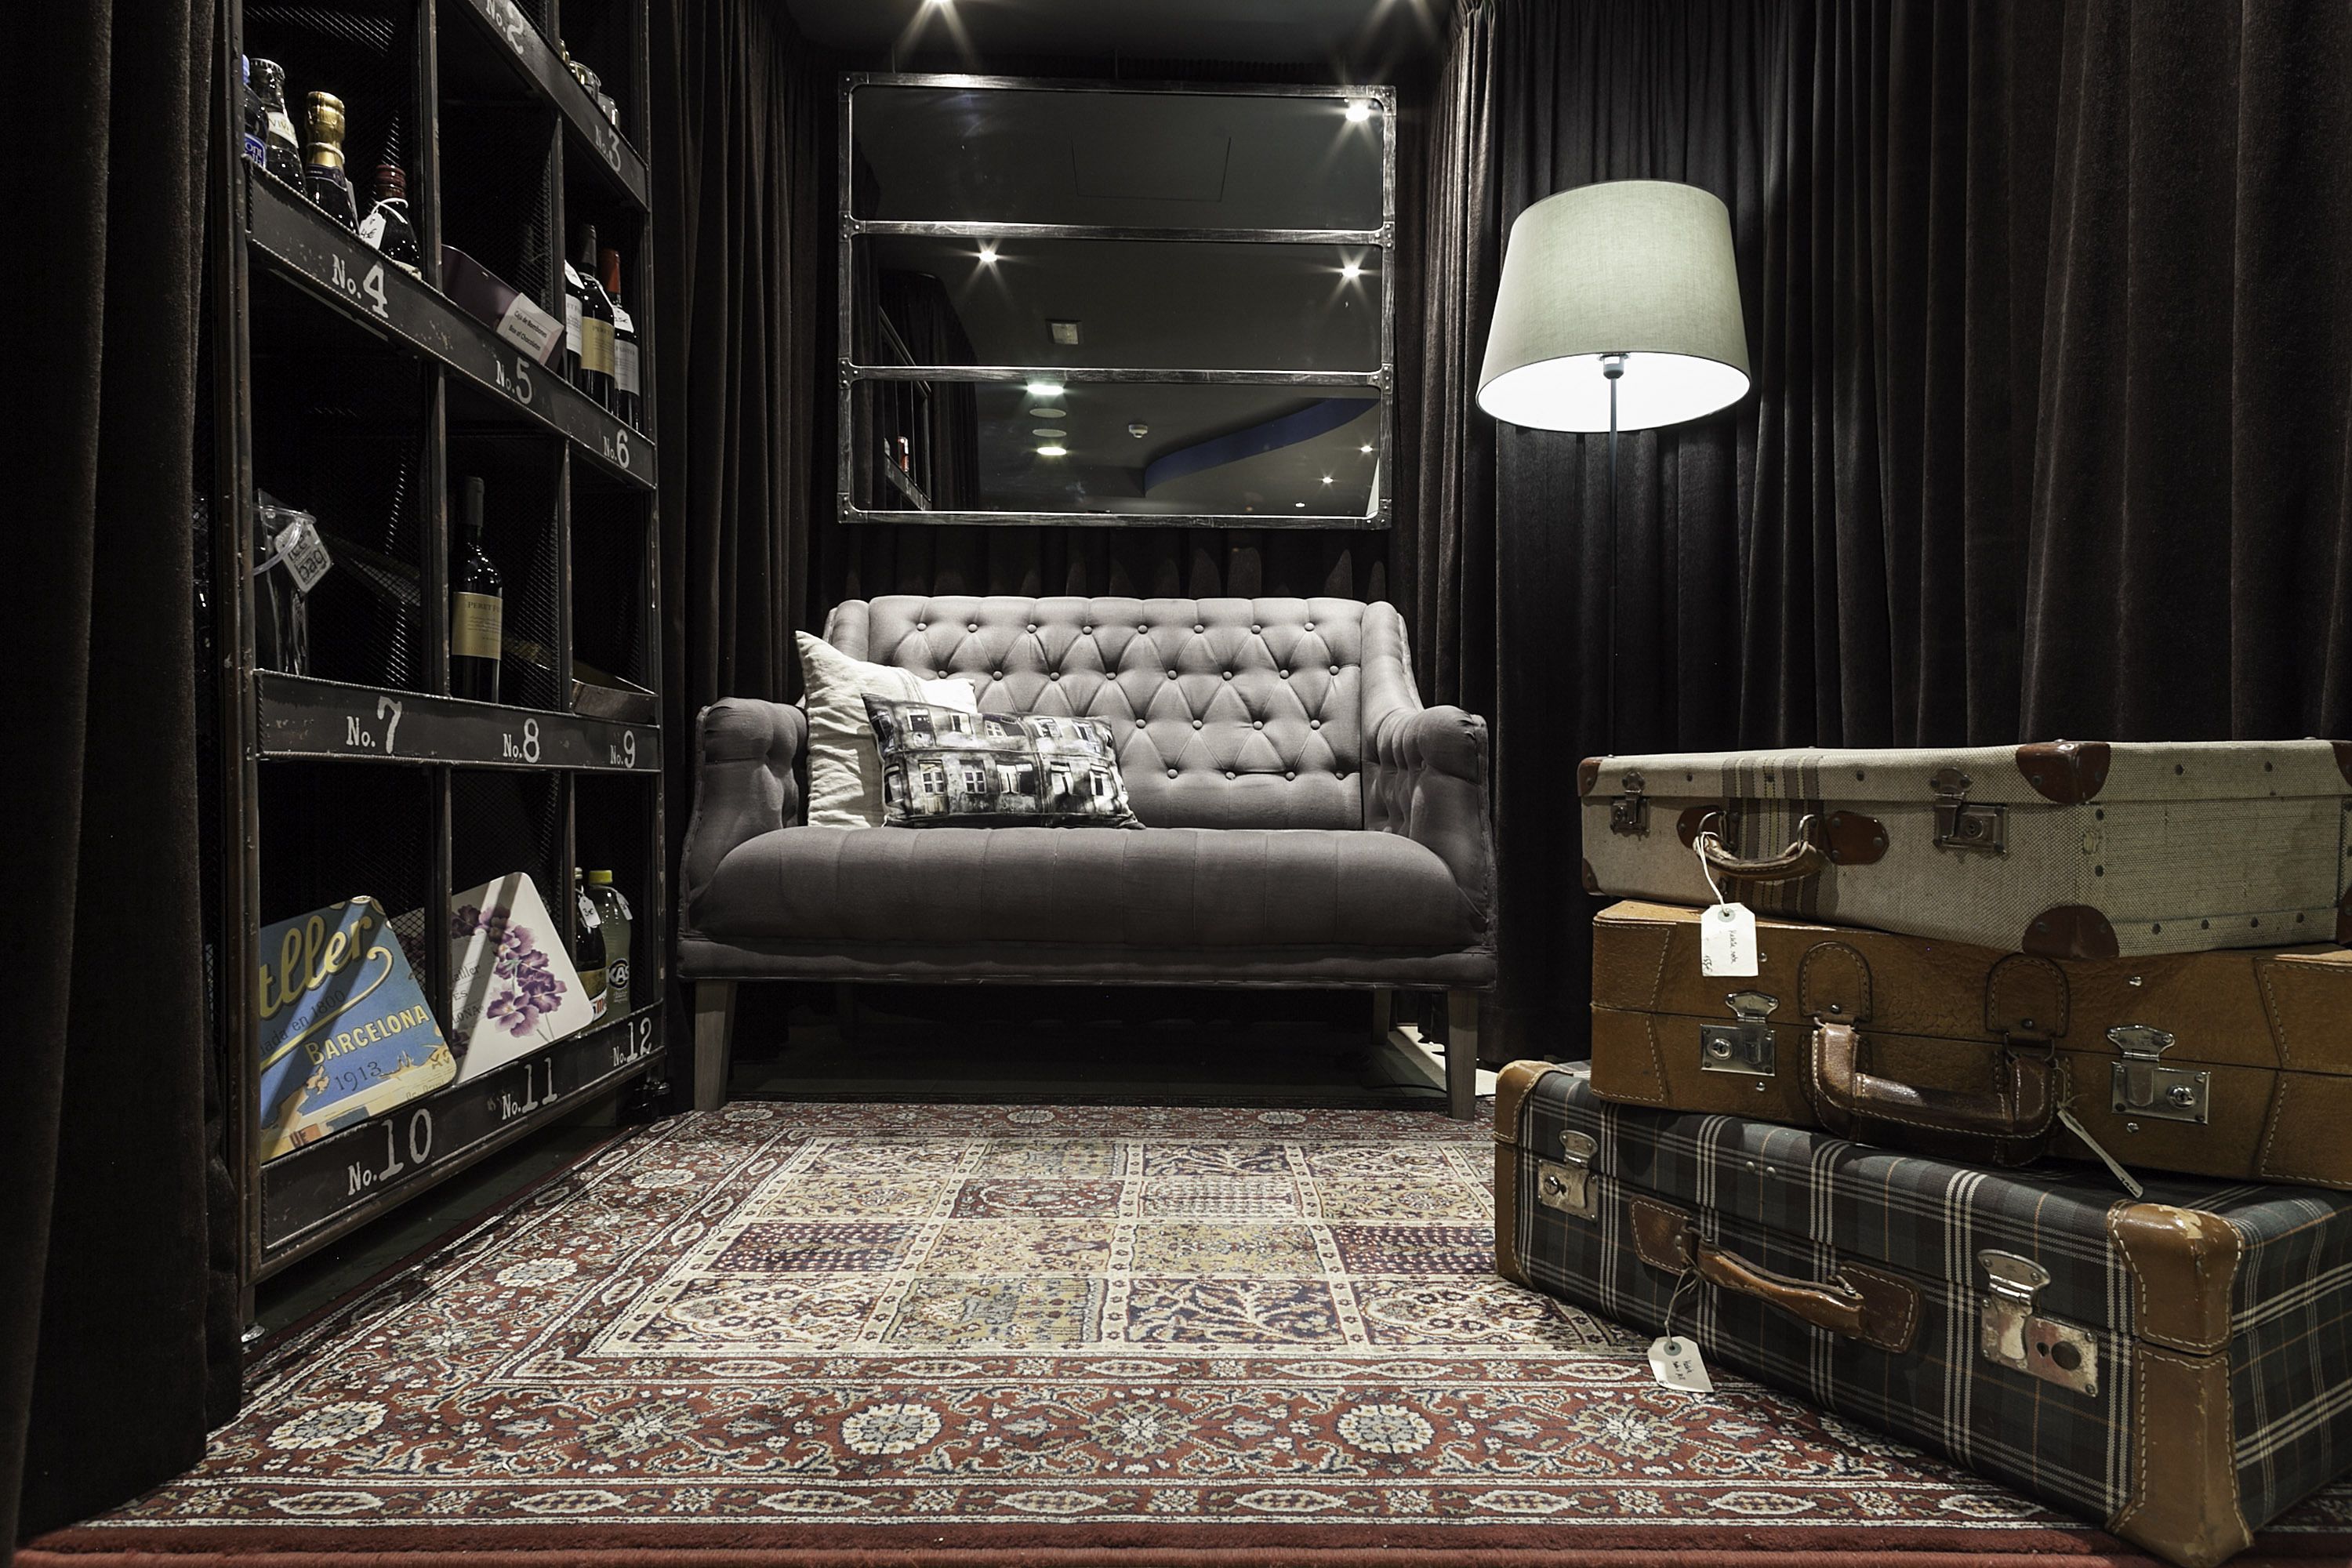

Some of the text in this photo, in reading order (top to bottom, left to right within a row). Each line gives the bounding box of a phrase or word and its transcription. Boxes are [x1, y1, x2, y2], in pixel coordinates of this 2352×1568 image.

[292, 1017, 309, 1032] en
[310, 989, 346, 1022] 1800
[305, 1004, 430, 1066] BARCELONA
[335, 1061, 383, 1092] 1913
